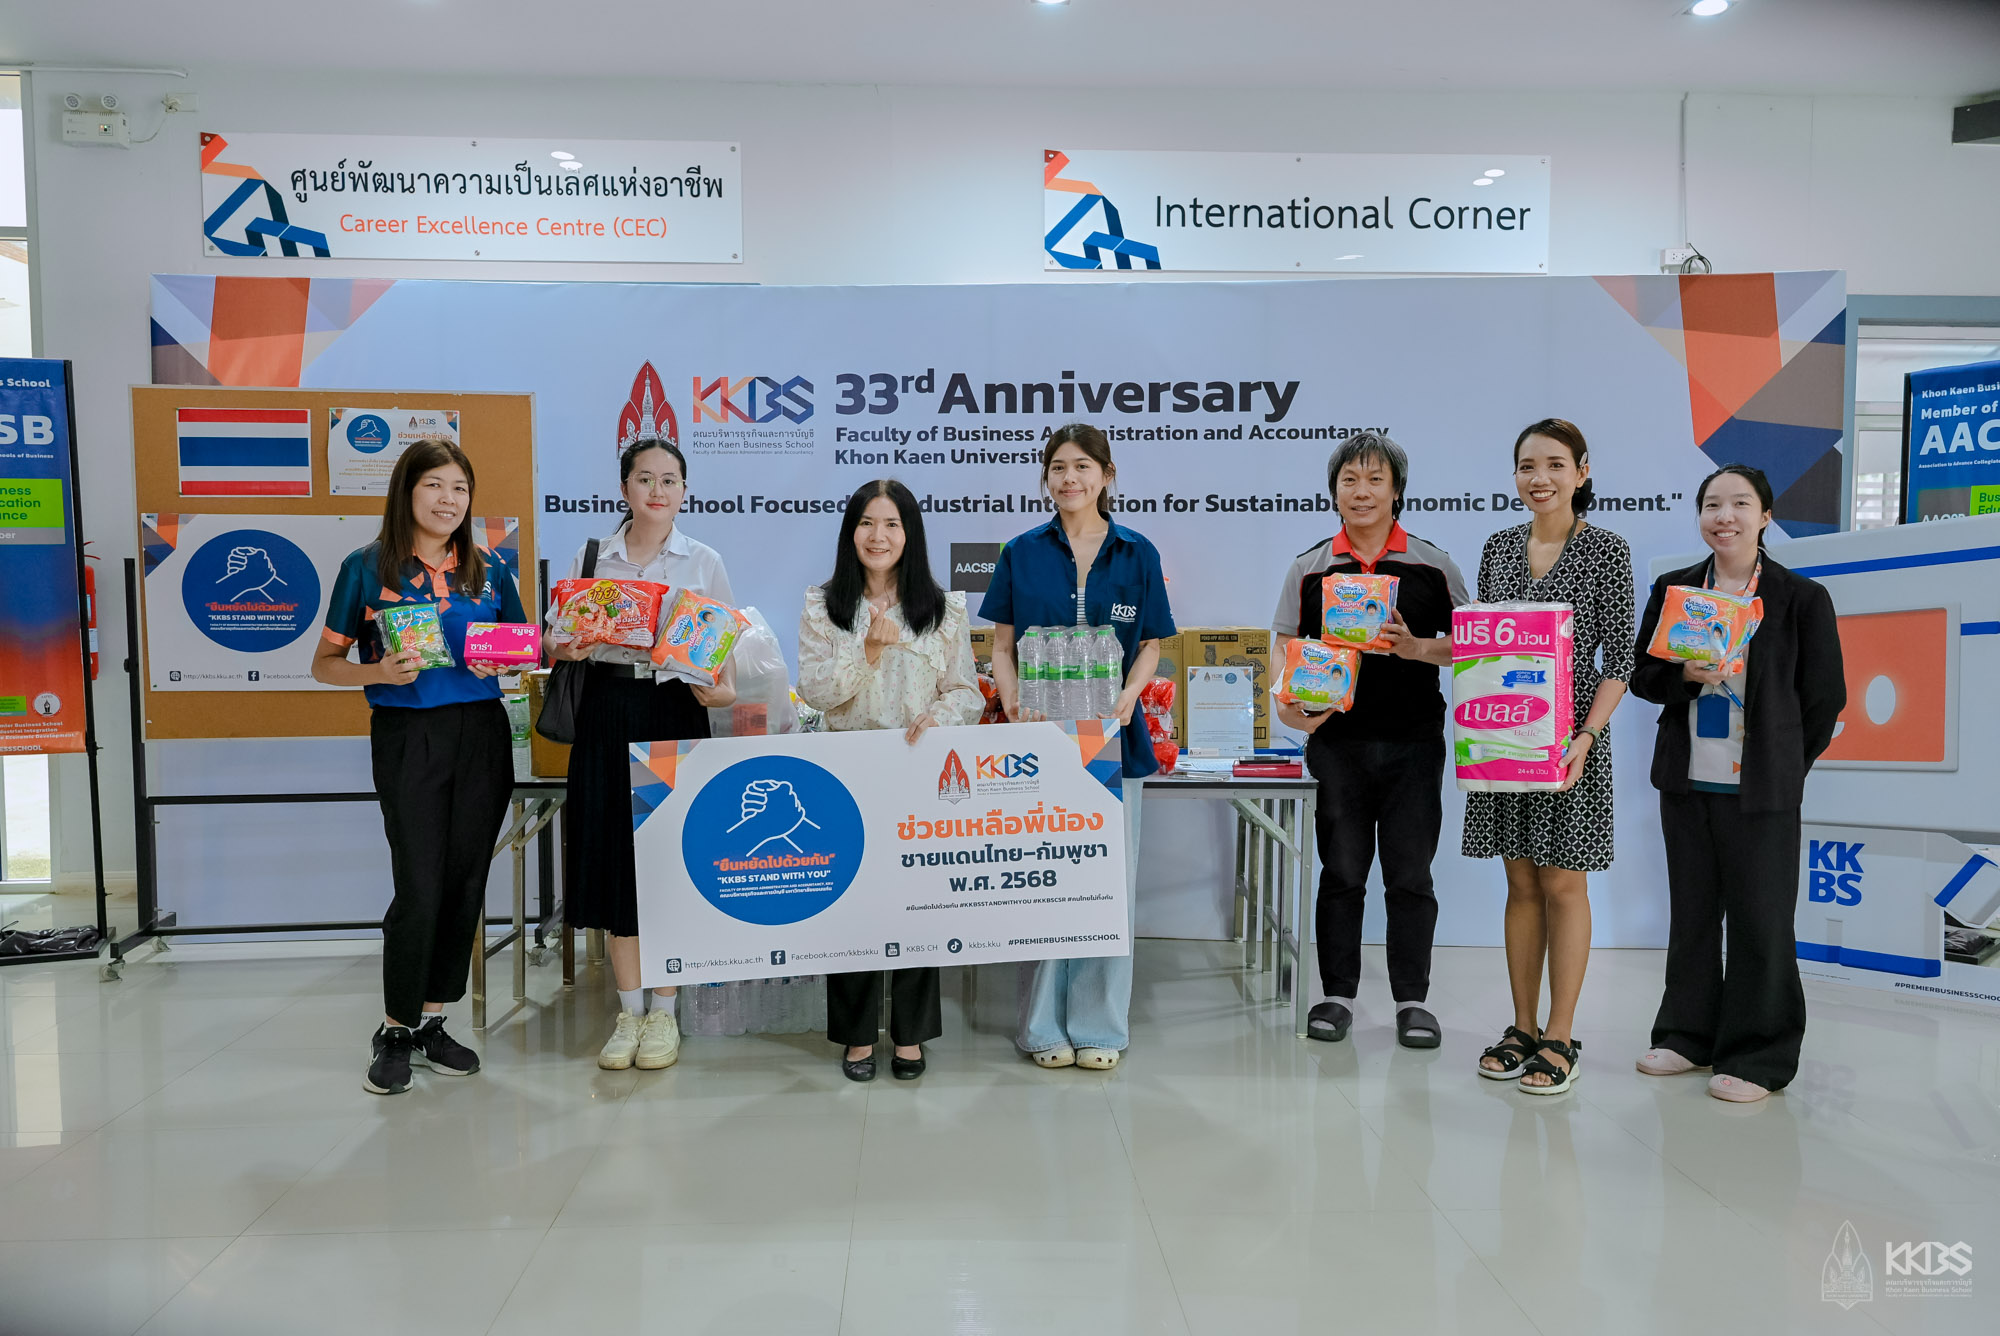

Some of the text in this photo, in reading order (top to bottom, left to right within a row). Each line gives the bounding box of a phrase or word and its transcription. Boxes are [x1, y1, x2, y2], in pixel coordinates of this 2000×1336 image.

[1155, 195, 1532, 231] International Corner
[340, 213, 668, 239] Career Excellence Centre (CEC)
[7, 378, 51, 388] School
[1922, 389, 1947, 399] Khon
[1950, 385, 1975, 396] Kaen
[693, 375, 814, 425] KKBS
[835, 368, 1300, 422] 33rd Anniversary
[1921, 400, 1998, 420] Member of
[693, 429, 814, 440] คณะบริหารธุรกิจและการบัญชี
[836, 426, 917, 445] Faculty
[921, 425, 939, 442] of
[943, 425, 1035, 442] Business
[1204, 424, 1242, 441] and
[693, 440, 814, 449] Khon Kaen Business School
[835, 447, 1044, 465] Khon Kaen Universit
[545, 494, 629, 513] Busine
[679, 494, 745, 514] chool
[1163, 493, 1199, 512] for
[955, 562, 996, 573] AACSB
[1453, 617, 1549, 647] ฟรี 6 ม้วน
[470, 642, 493, 650] ซาร่า
[1464, 696, 1535, 723] เบลล์
[976, 752, 1039, 780] KKBS
[897, 801, 1104, 841] ช่วยเหลือพี่น้อง
[748, 873, 780, 883] STAND
[781, 871, 805, 881] WITH
[949, 869, 1057, 892] พ.ศ. 2568
[959, 899, 1032, 908] #KKBSSTANDWITHYOU
[906, 944, 938, 953] KKBS CH
[1008, 934, 1120, 946] #PREMIERBUSINESSSCHOOL
[685, 956, 764, 969] http://kkbs.kku.ac.th
[791, 948, 879, 961] Facebook.com/kkbskku
